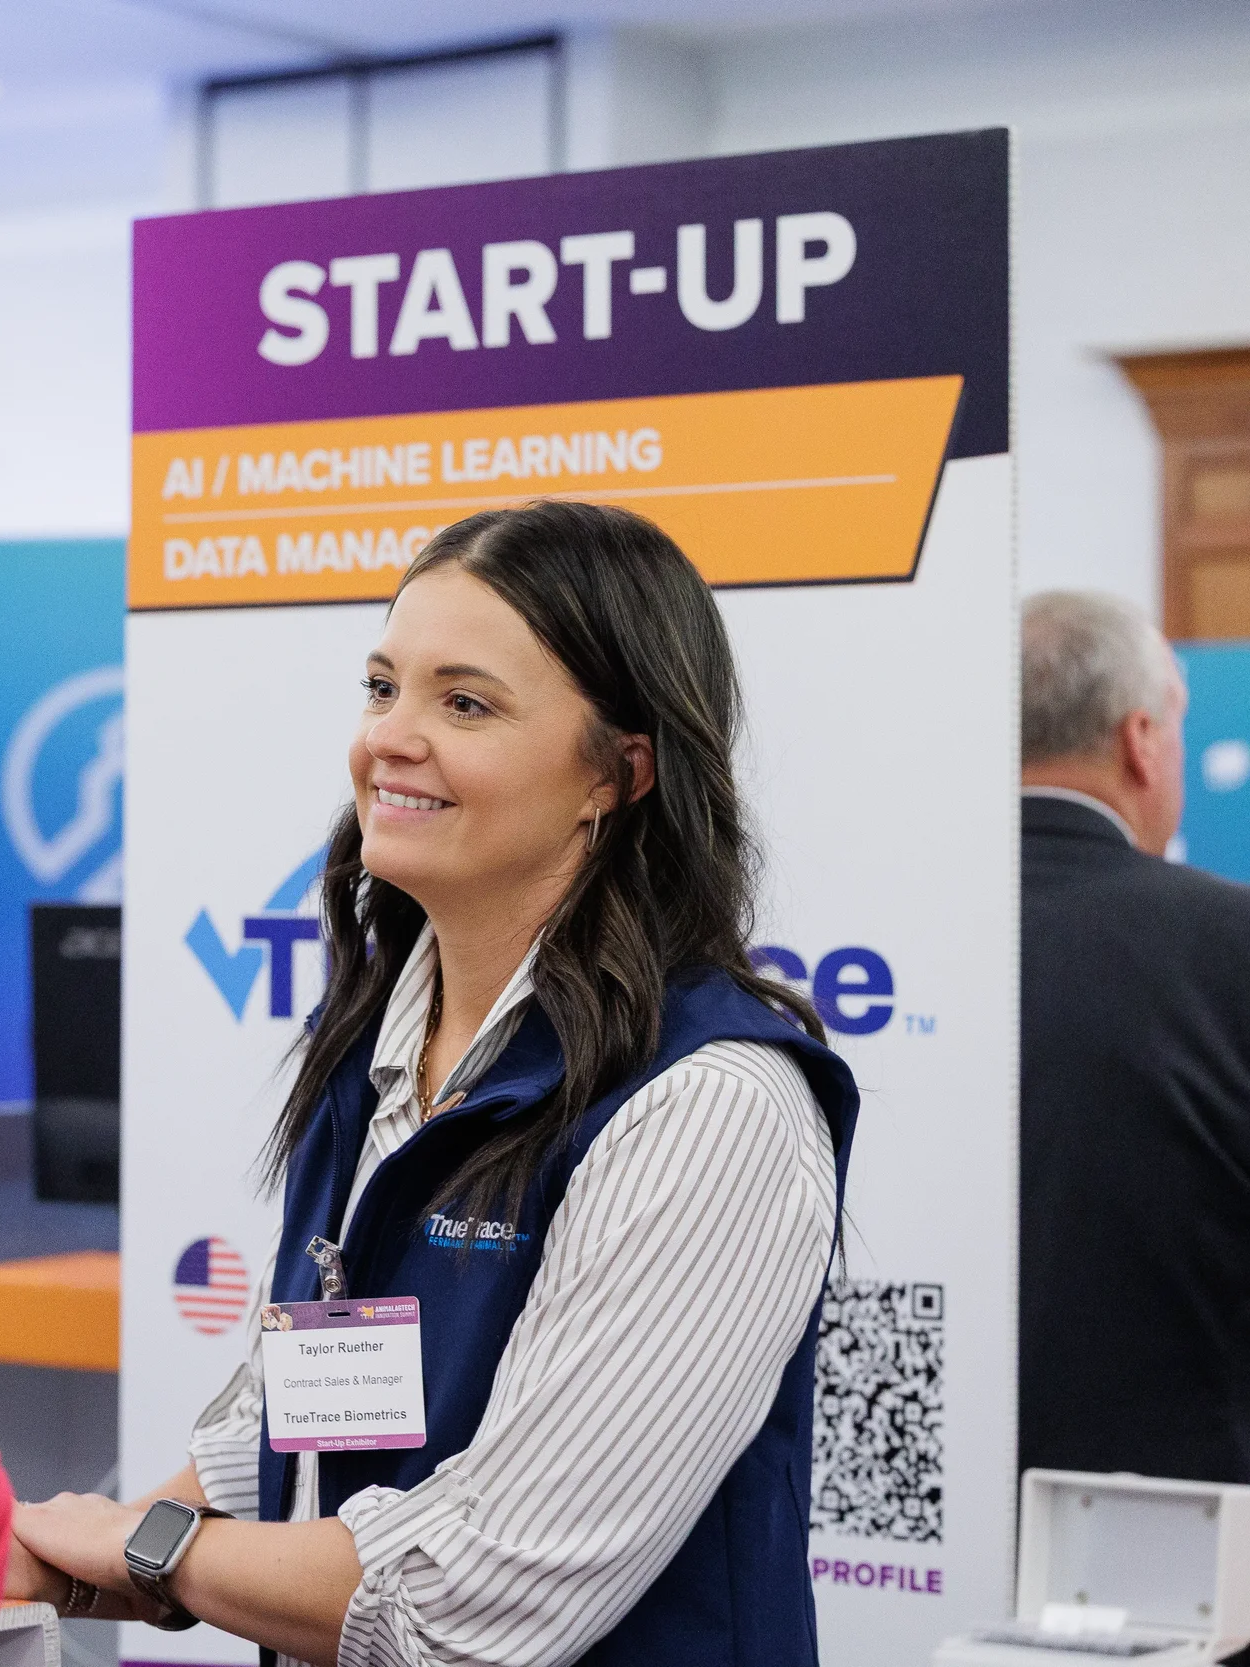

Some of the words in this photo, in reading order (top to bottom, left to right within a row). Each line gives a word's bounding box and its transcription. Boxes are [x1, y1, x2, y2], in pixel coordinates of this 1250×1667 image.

[258, 211, 857, 366] START-UP
[162, 456, 204, 499] AI
[212, 455, 230, 498] /
[238, 443, 431, 496] MACHINE
[441, 427, 663, 484] LEARNING
[163, 534, 268, 580] DATA
[276, 524, 447, 576] MANAG
[430, 1213, 514, 1239] Truerace
[298, 1343, 334, 1357] Taylor
[338, 1341, 384, 1354] Ruether
[283, 1377, 322, 1389] Contract
[324, 1376, 350, 1387] Sales
[352, 1375, 360, 1386] &
[362, 1374, 403, 1387] Manager
[284, 1411, 341, 1424] TrueTrace
[344, 1408, 407, 1422] Biometrics
[316, 1440, 345, 1448] Start-Up
[345, 1438, 377, 1447] Exhibitor
[812, 1557, 943, 1595] PROFILE
